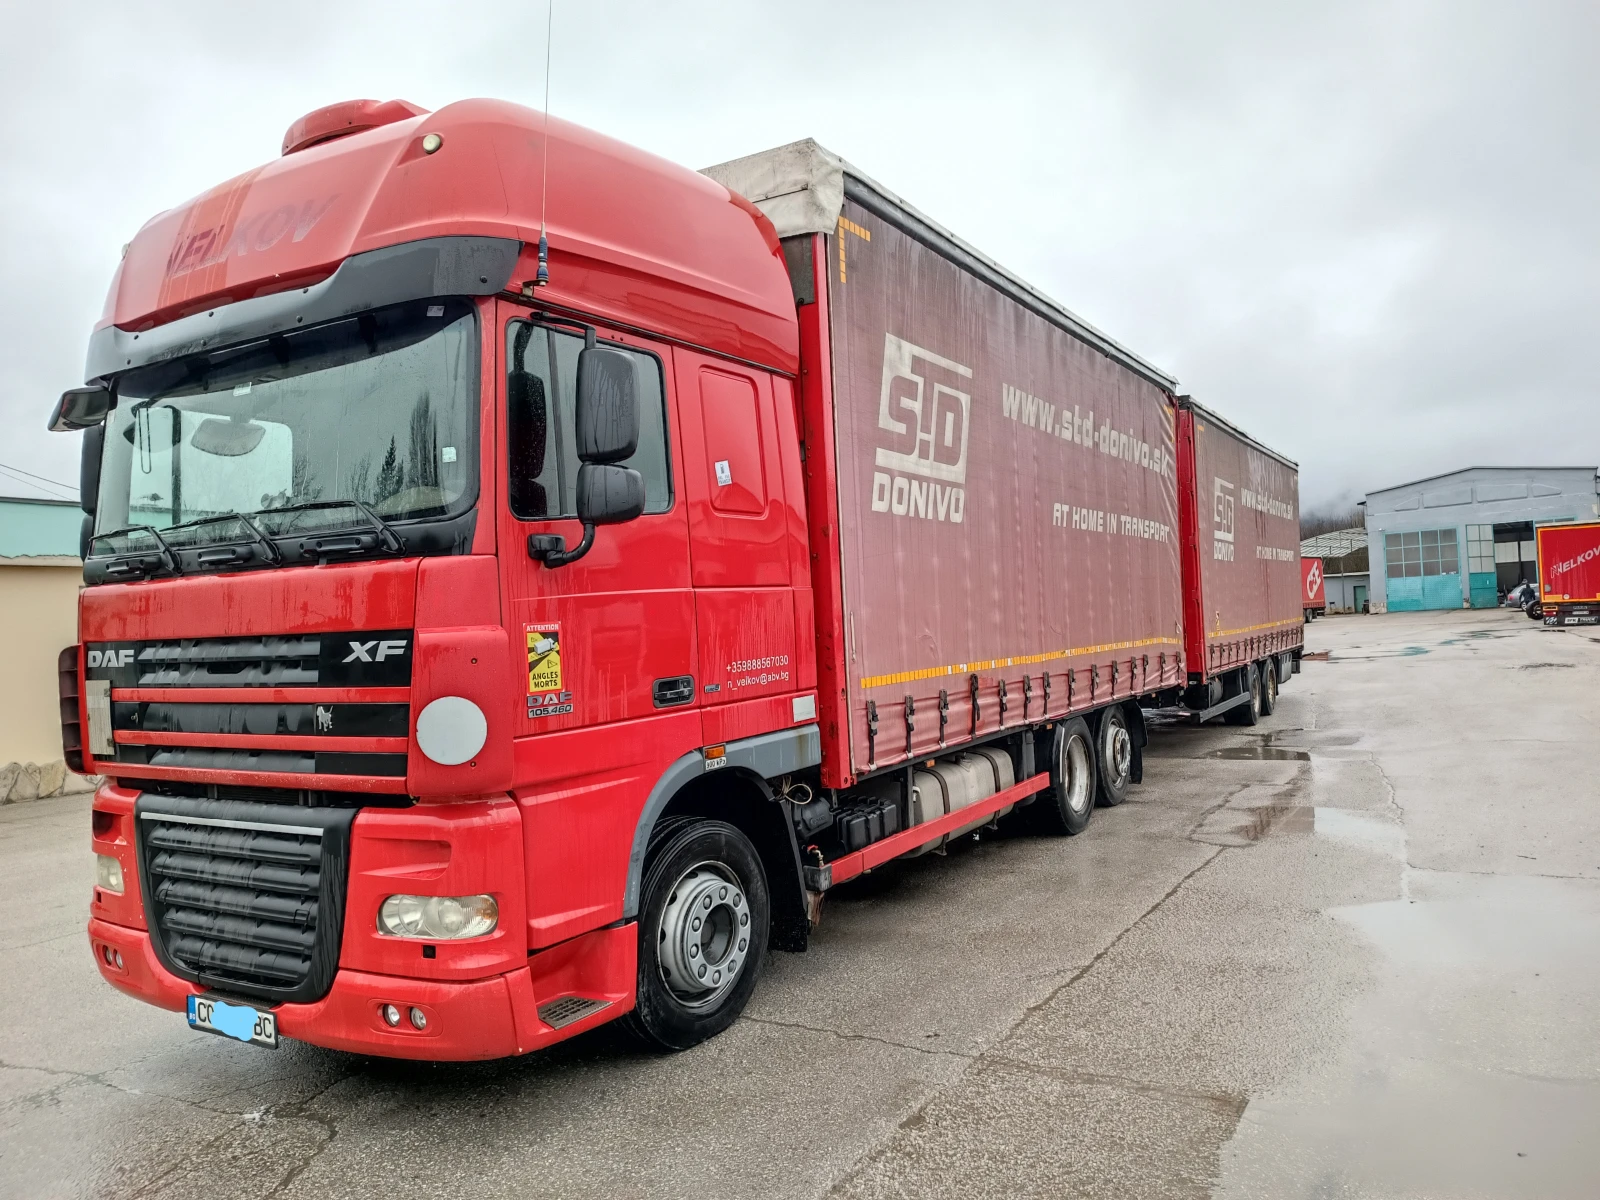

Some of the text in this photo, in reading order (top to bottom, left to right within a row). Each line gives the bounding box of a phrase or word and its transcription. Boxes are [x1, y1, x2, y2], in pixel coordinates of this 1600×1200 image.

[1002, 382, 1168, 477] www.std-donivo.sk
[872, 471, 965, 523] DONIVO
[1053, 502, 1169, 543] AT HOME IN TRANSPORT
[526, 623, 559, 632] ATTENTION
[87, 650, 134, 667] DAF
[341, 640, 407, 662] XF
[726, 655, 788, 673] +359888567030
[532, 671, 558, 681] ANGLES
[533, 679, 558, 688] MORTS
[727, 671, 789, 691] n_velkov@abv.bg
[527, 691, 572, 707] DAF
[529, 704, 572, 717] 105.460
